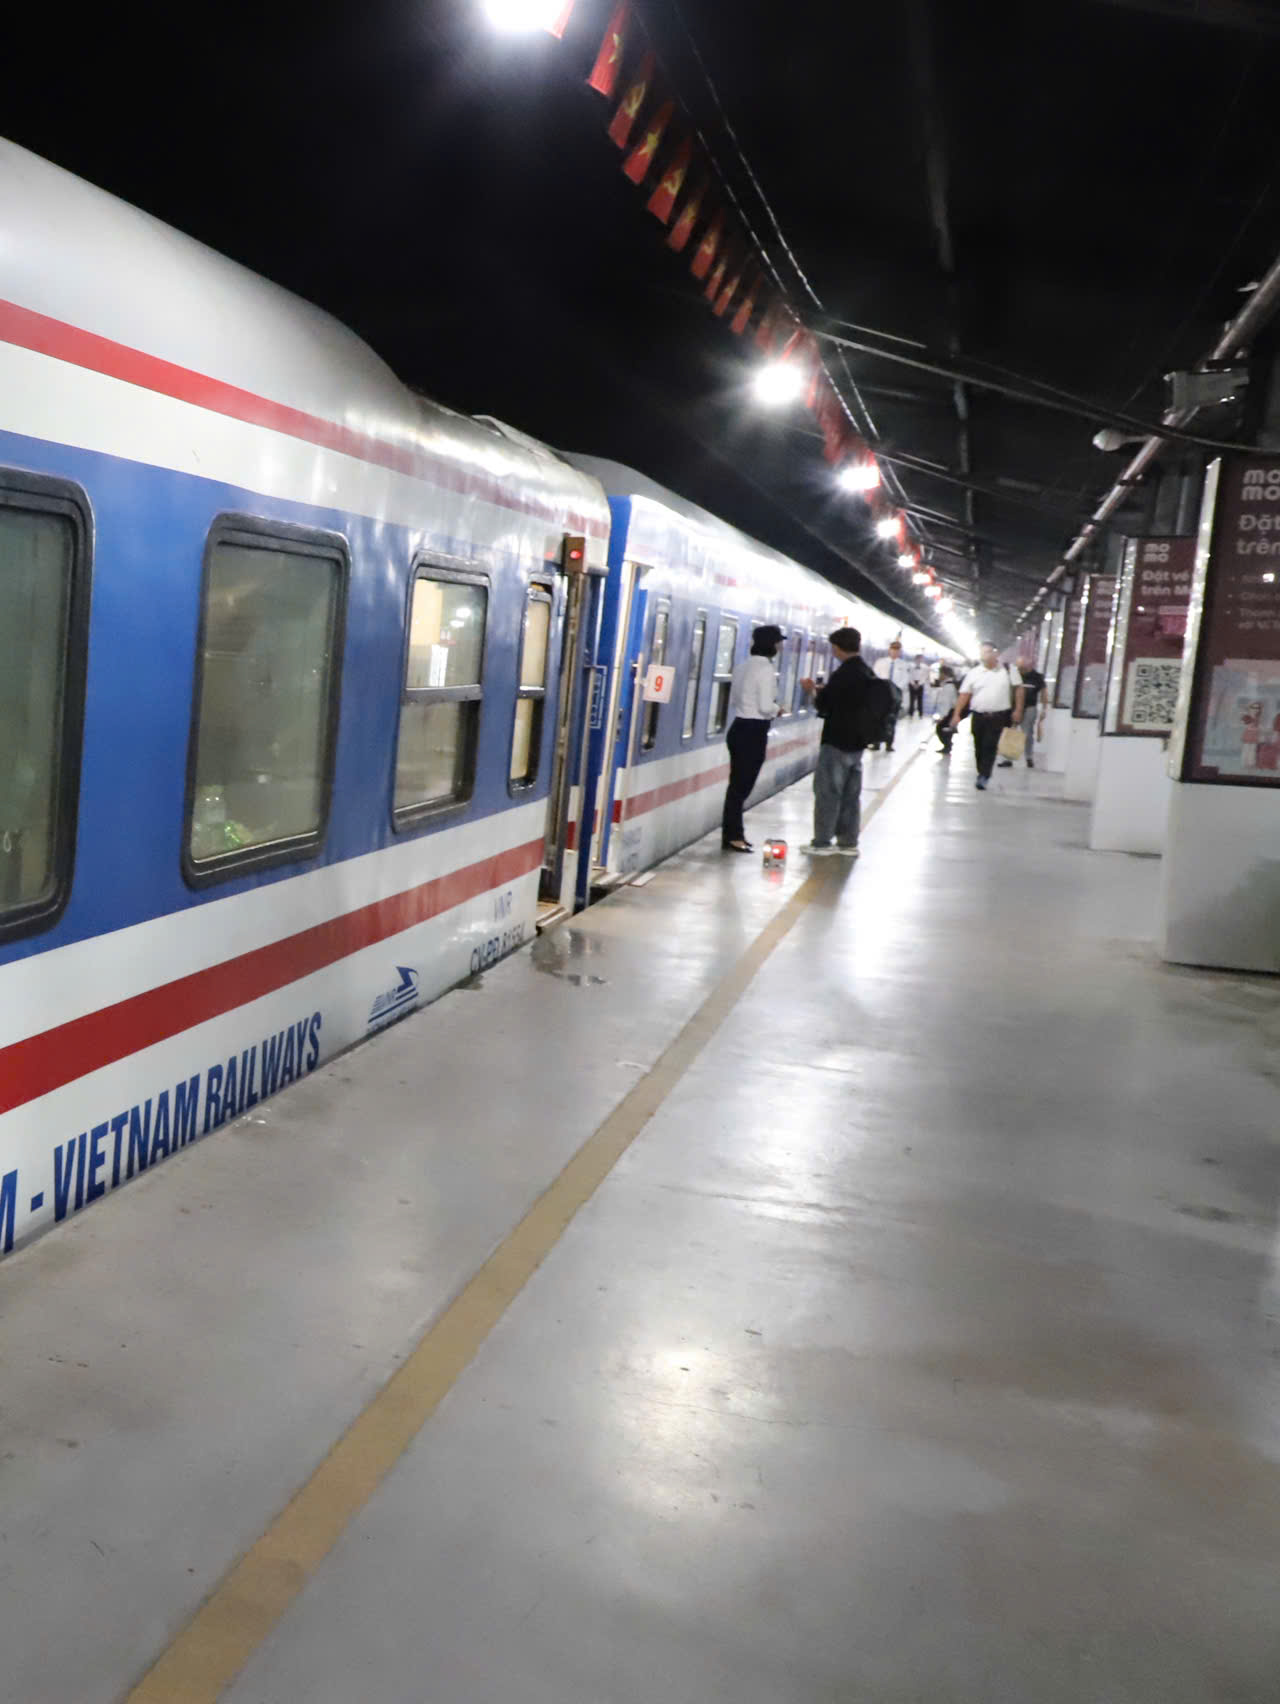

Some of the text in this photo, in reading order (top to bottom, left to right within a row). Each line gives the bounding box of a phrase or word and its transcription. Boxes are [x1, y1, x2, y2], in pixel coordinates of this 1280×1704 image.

[655, 675, 664, 693] 9
[54, 1073, 201, 1223] VIETNAM
[203, 1011, 322, 1134] RAILWAYS
